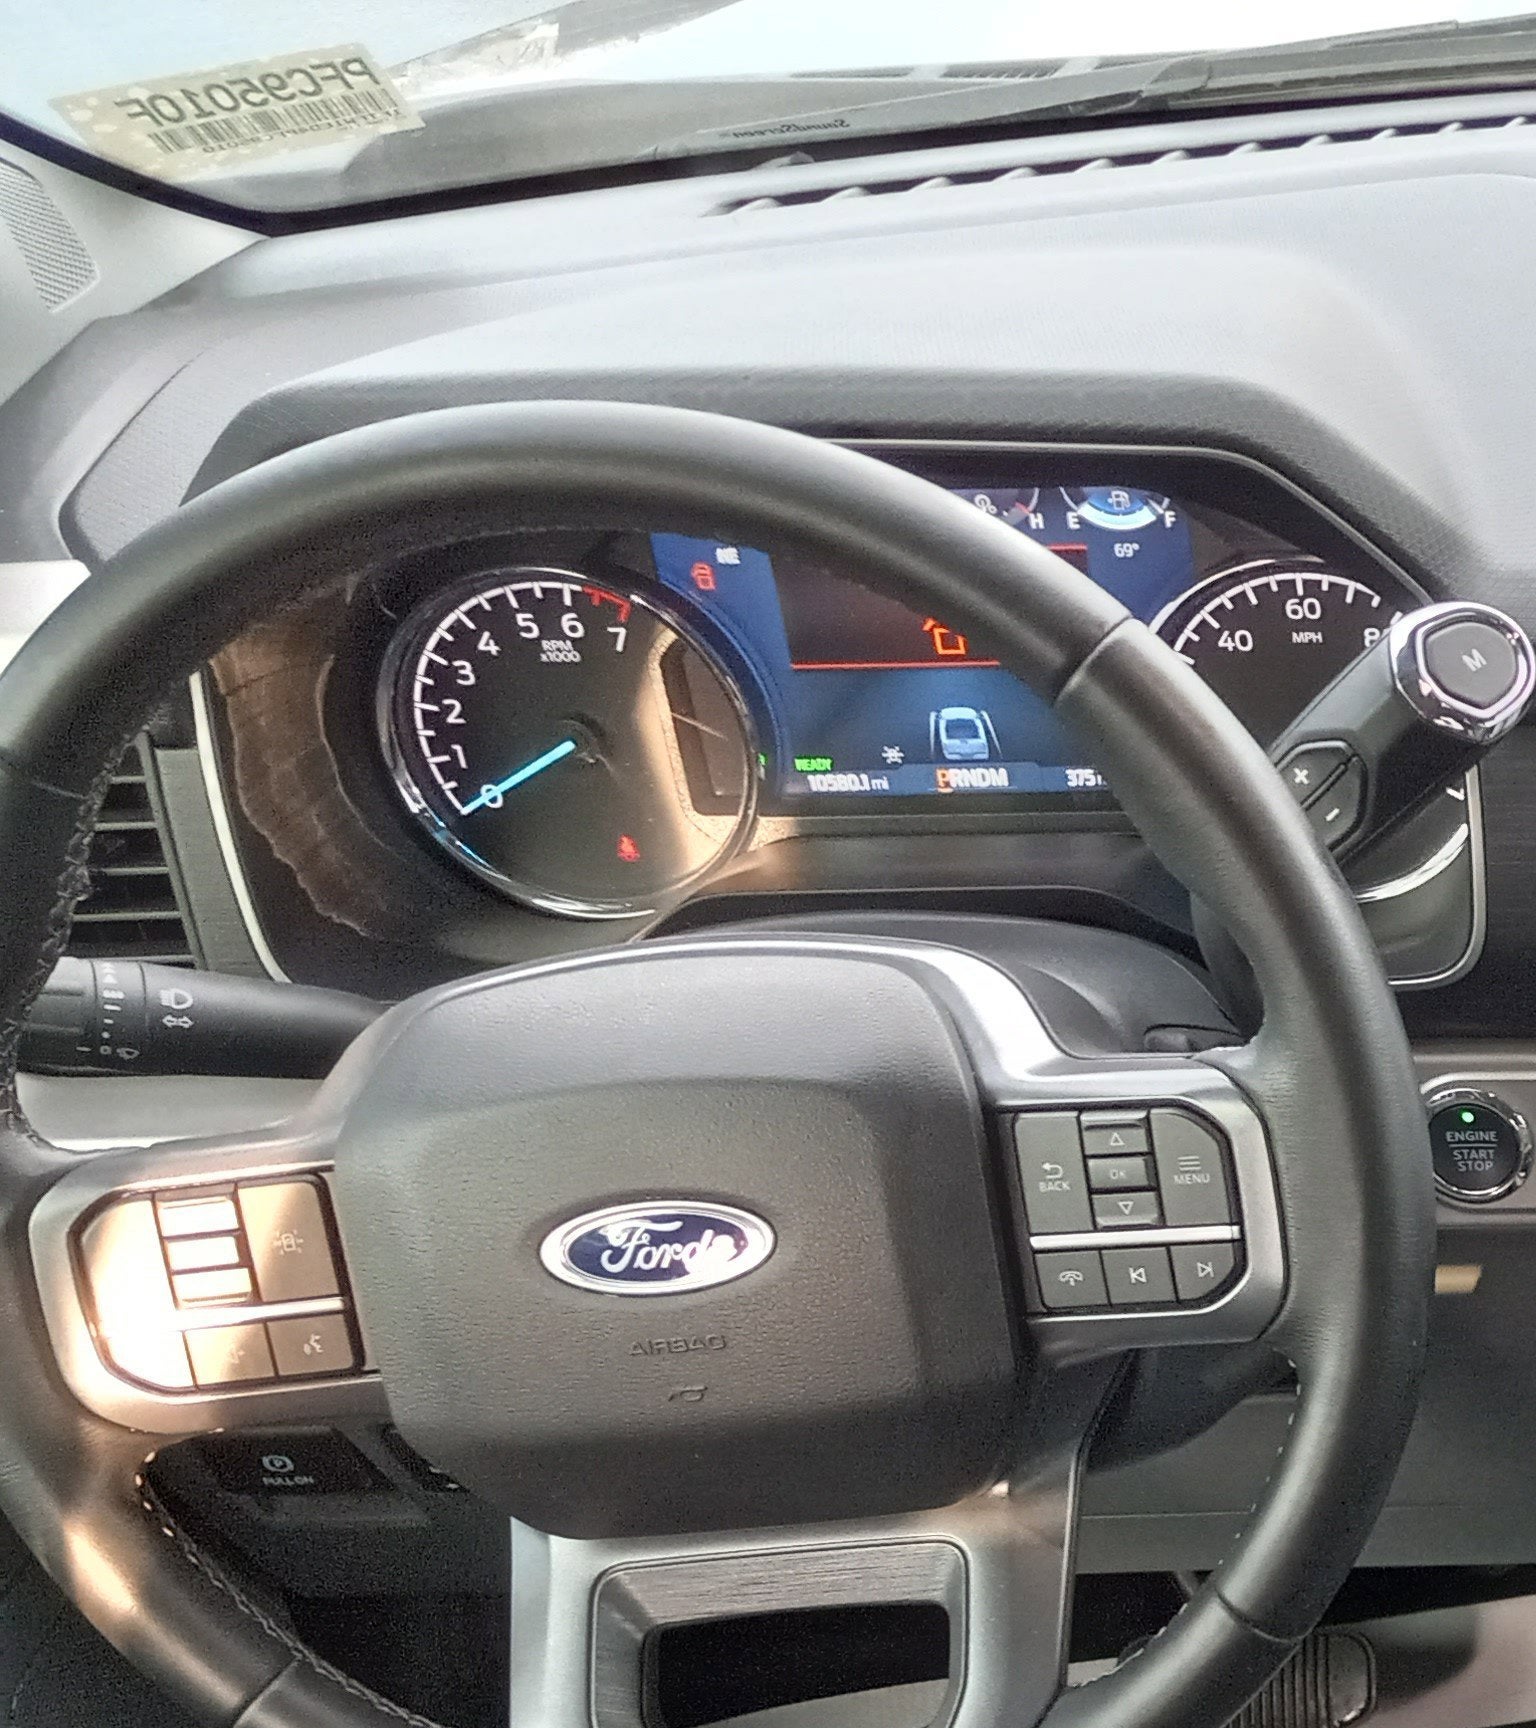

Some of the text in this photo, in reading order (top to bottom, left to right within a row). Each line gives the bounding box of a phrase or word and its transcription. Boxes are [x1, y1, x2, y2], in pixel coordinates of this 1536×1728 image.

[1030, 513, 1044, 529] H
[1067, 513, 1080, 529] E
[1164, 511, 1176, 528] F
[1285, 598, 1321, 620] 60
[516, 613, 540, 640] 5
[561, 612, 584, 638] 6
[478, 632, 501, 656] 4
[542, 639, 574, 651] RPM
[607, 627, 628, 653] 7
[1218, 629, 1253, 652] 40
[1292, 632, 1322, 644] MPH
[540, 651, 581, 662] x1000
[1462, 648, 1488, 672] M
[453, 660, 475, 686] 3
[443, 699, 467, 724] 2
[451, 744, 468, 769] 1
[1446, 1130, 1498, 1142] ENGINE
[1453, 1149, 1495, 1160] START
[1109, 1168, 1126, 1180] OK
[1457, 1161, 1494, 1172] STOP
[1039, 1180, 1071, 1192] BACK
[1174, 1173, 1210, 1185] MENU
[599, 1219, 737, 1275] Ford
[628, 1333, 727, 1357] AIRBAG
